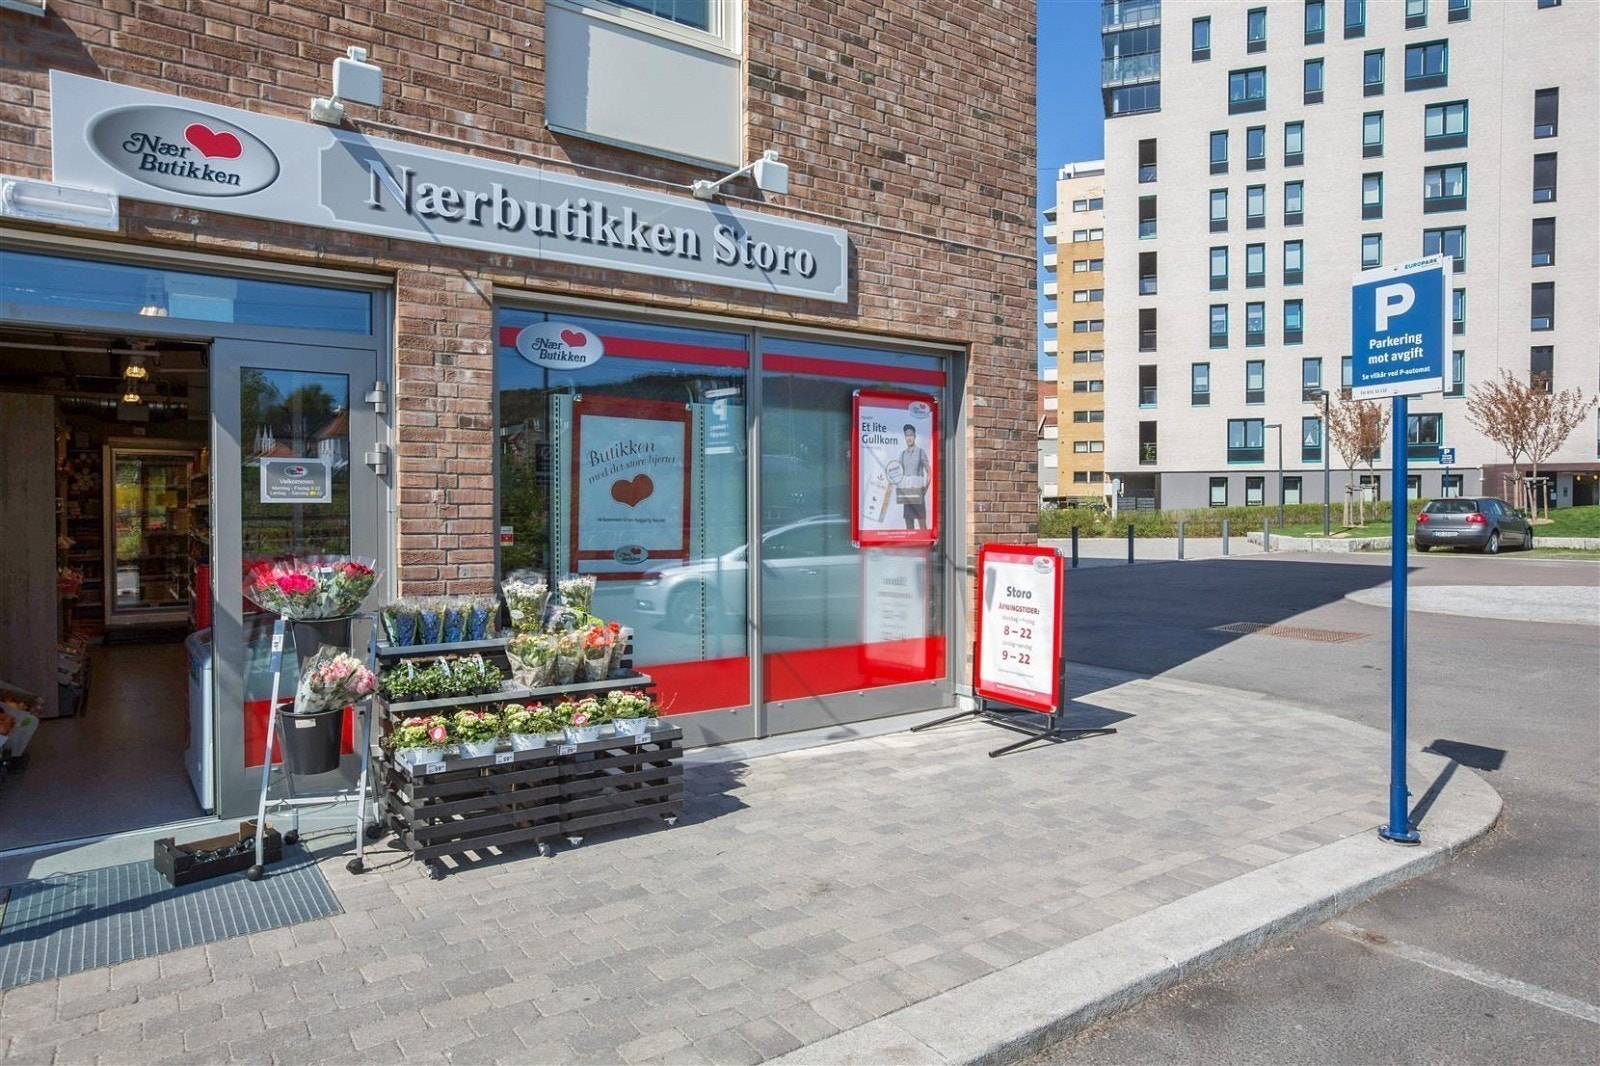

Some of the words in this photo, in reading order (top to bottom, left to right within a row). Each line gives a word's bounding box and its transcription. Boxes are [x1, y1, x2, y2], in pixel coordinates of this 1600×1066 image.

[122, 132, 191, 160] Nær
[139, 152, 241, 187] Butikken
[364, 158, 702, 260] Nærbutikken
[712, 224, 817, 279] Storo
[1404, 258, 1438, 270] EUROPARK
[1375, 282, 1416, 333] P
[531, 337, 564, 351] Nær
[1369, 333, 1423, 350] Parkering
[539, 348, 587, 363] Butikken
[1368, 353, 1389, 365] mot
[1391, 347, 1424, 362] avgift
[1361, 373, 1370, 381] Se
[1370, 371, 1387, 380] vilkår
[1387, 369, 1399, 378] ved
[1399, 366, 1431, 375] P-automat
[861, 422, 871, 432] Et
[872, 422, 887, 433] lite
[861, 434, 899, 445] Gullkorn
[587, 439, 655, 467] Butikken
[588, 467, 609, 484] med
[610, 463, 624, 474] det
[625, 458, 647, 469] store
[648, 454, 676, 467] hjertet
[1006, 585, 1032, 600] Storo
[998, 602, 1040, 616] ÅPNINGSTIDER:
[1003, 625, 1010, 636] 8
[1020, 627, 1032, 639] 22
[1002, 650, 1008, 661] 9
[1018, 652, 1031, 665] 22
